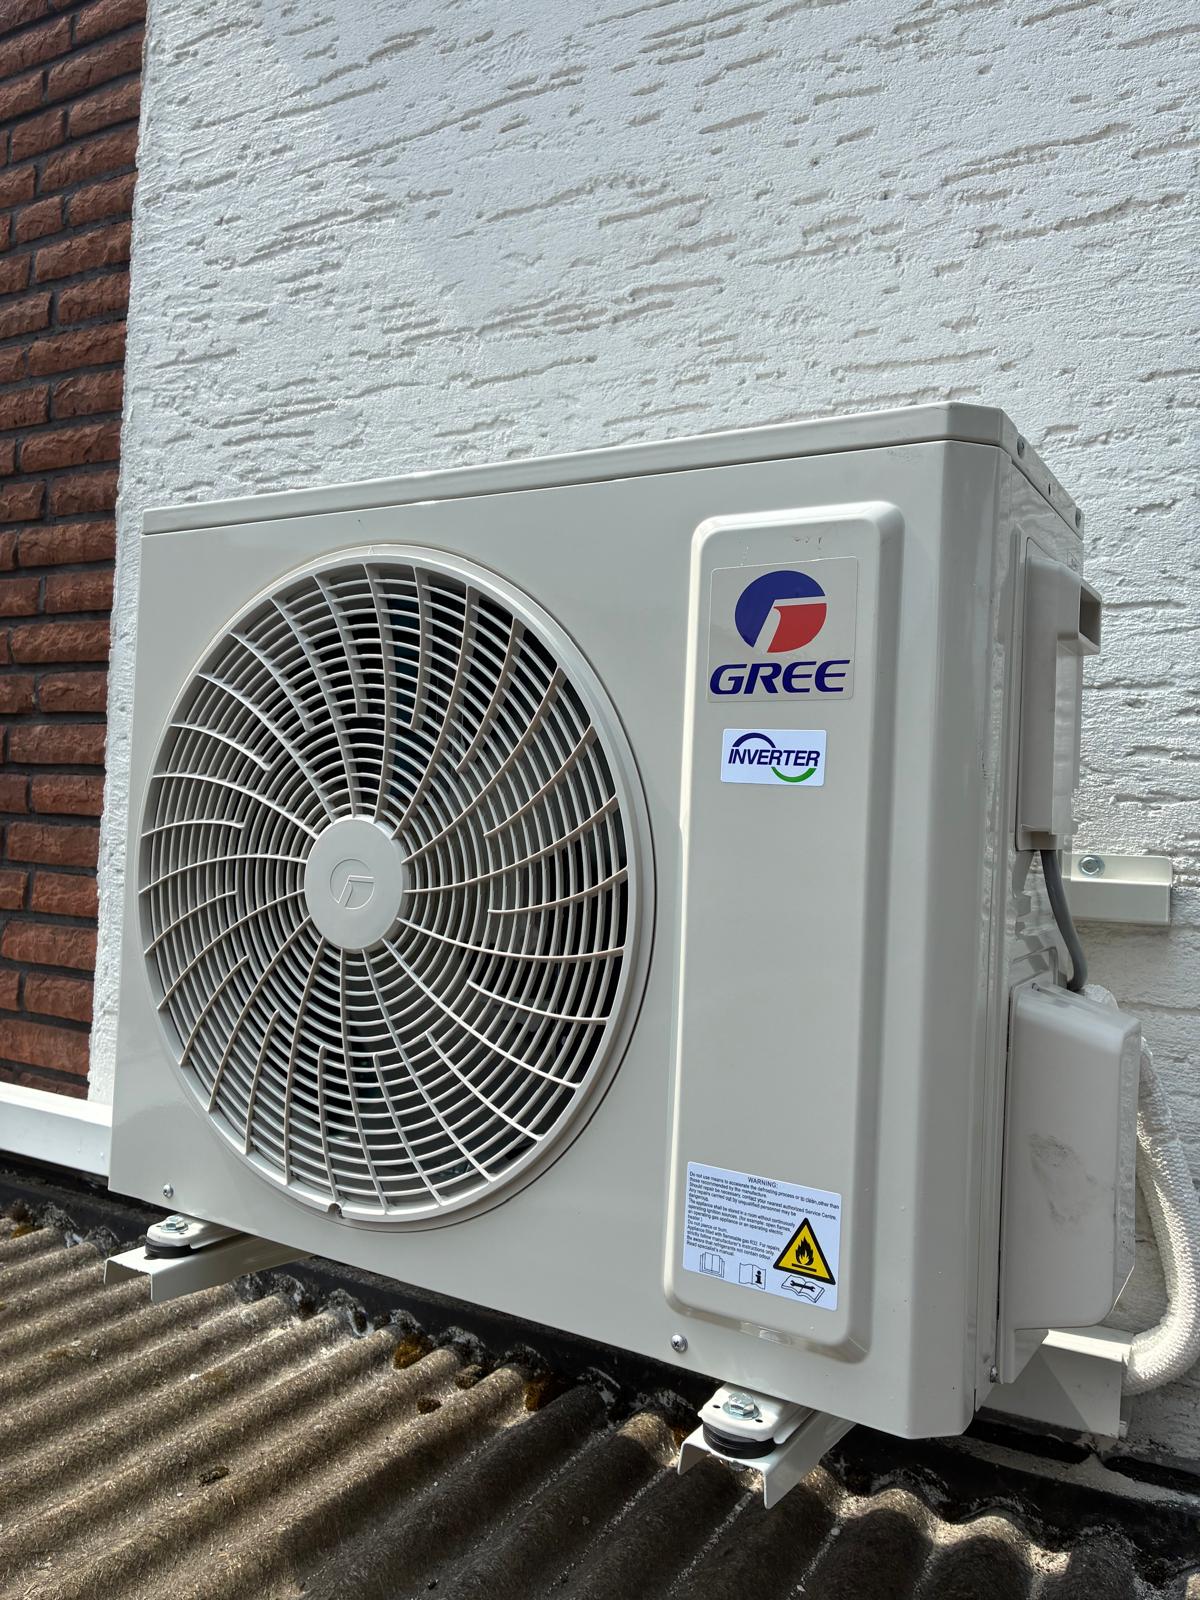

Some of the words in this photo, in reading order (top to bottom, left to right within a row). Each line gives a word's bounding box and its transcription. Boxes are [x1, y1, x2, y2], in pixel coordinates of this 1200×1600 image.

[709, 659, 850, 695] GREE
[728, 748, 821, 767] INVERTER
[748, 1177, 778, 1188] WARNING:
